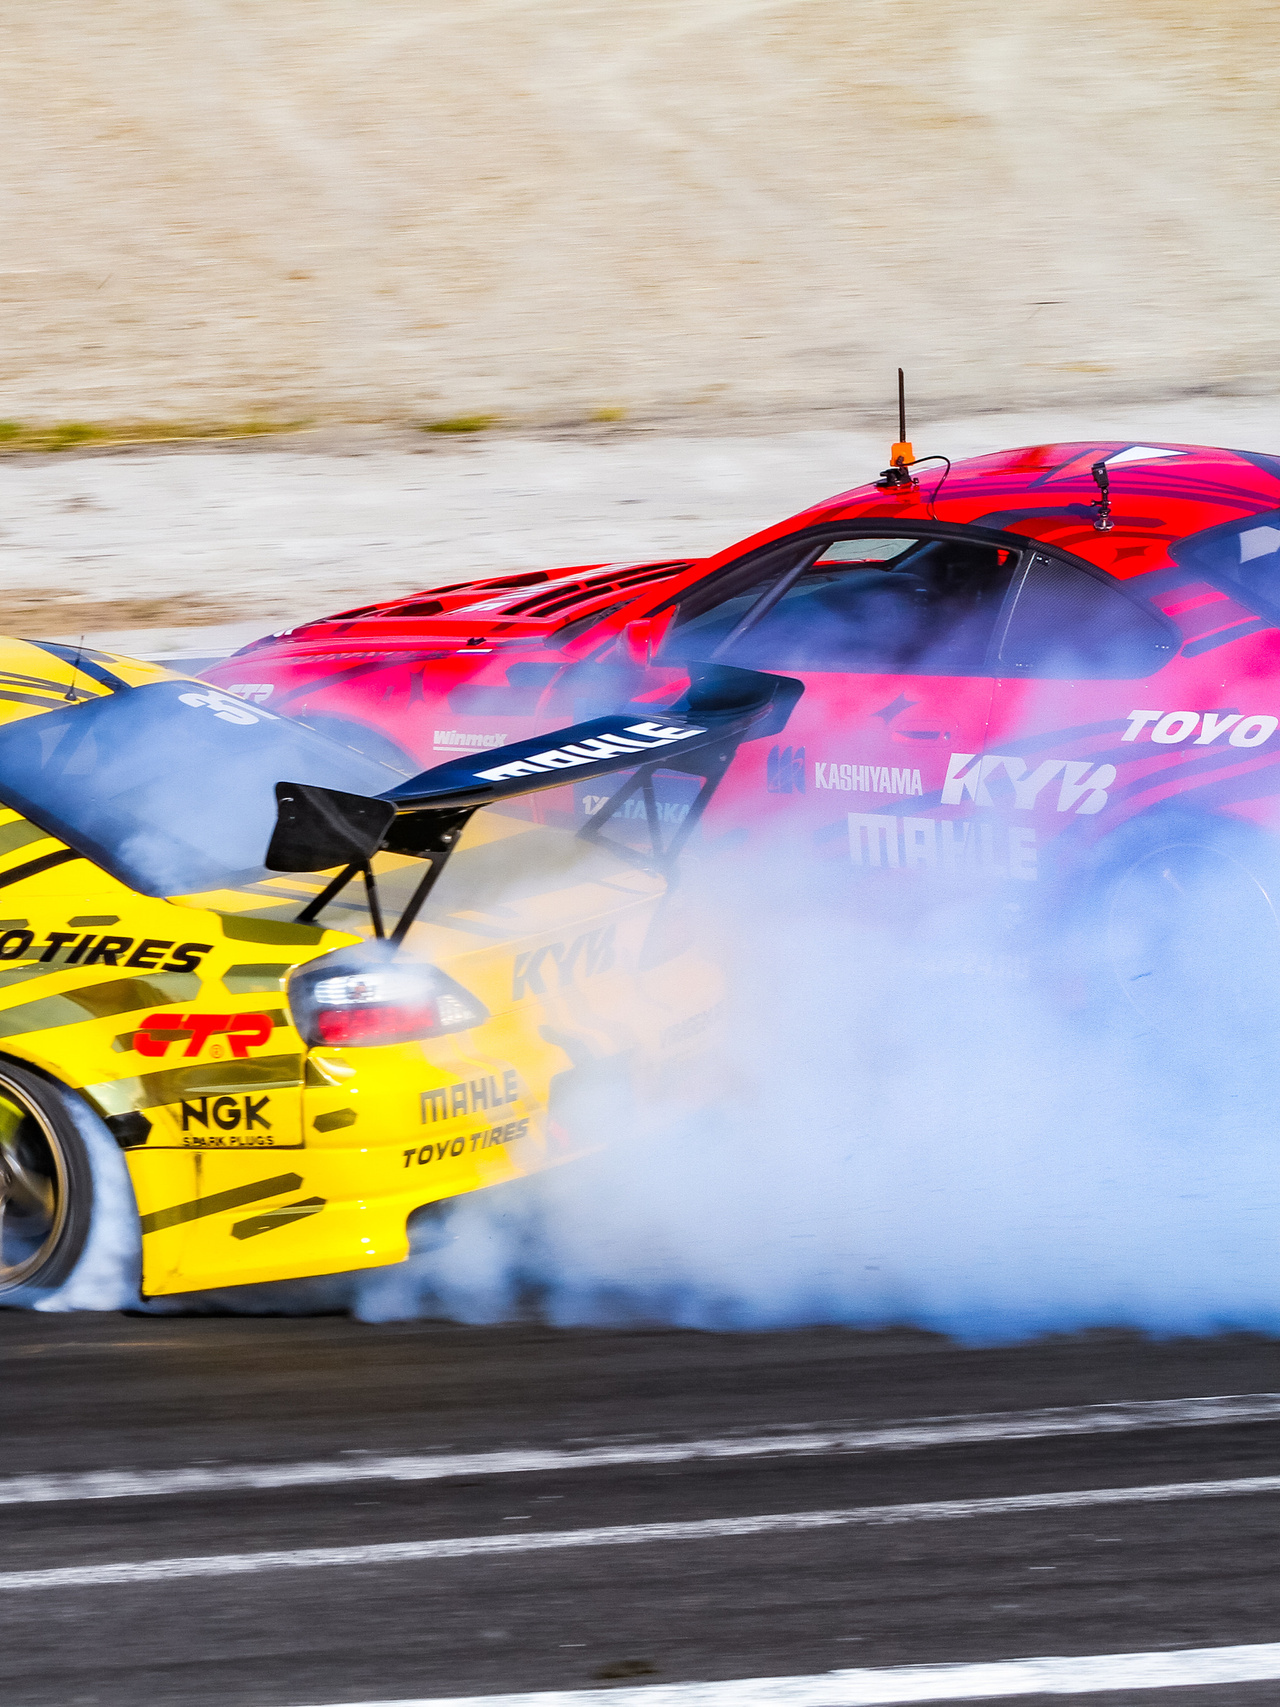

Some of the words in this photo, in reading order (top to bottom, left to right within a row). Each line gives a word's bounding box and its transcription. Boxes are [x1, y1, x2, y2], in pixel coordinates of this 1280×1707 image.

[472, 721, 708, 782] MAHLE
[1120, 709, 1280, 748] TOYO
[815, 762, 923, 797] KASHIYAMA
[940, 752, 1117, 815] KYB
[847, 812, 1039, 881] MAHLE
[39, 932, 215, 973] TIRES
[181, 1096, 272, 1131] NGK
[420, 1069, 519, 1125] MAHLE
[183, 1136, 226, 1146] SPARK
[230, 1135, 274, 1146] PLUGS
[402, 1136, 466, 1168] TOYO
[469, 1117, 530, 1153] TIRES
